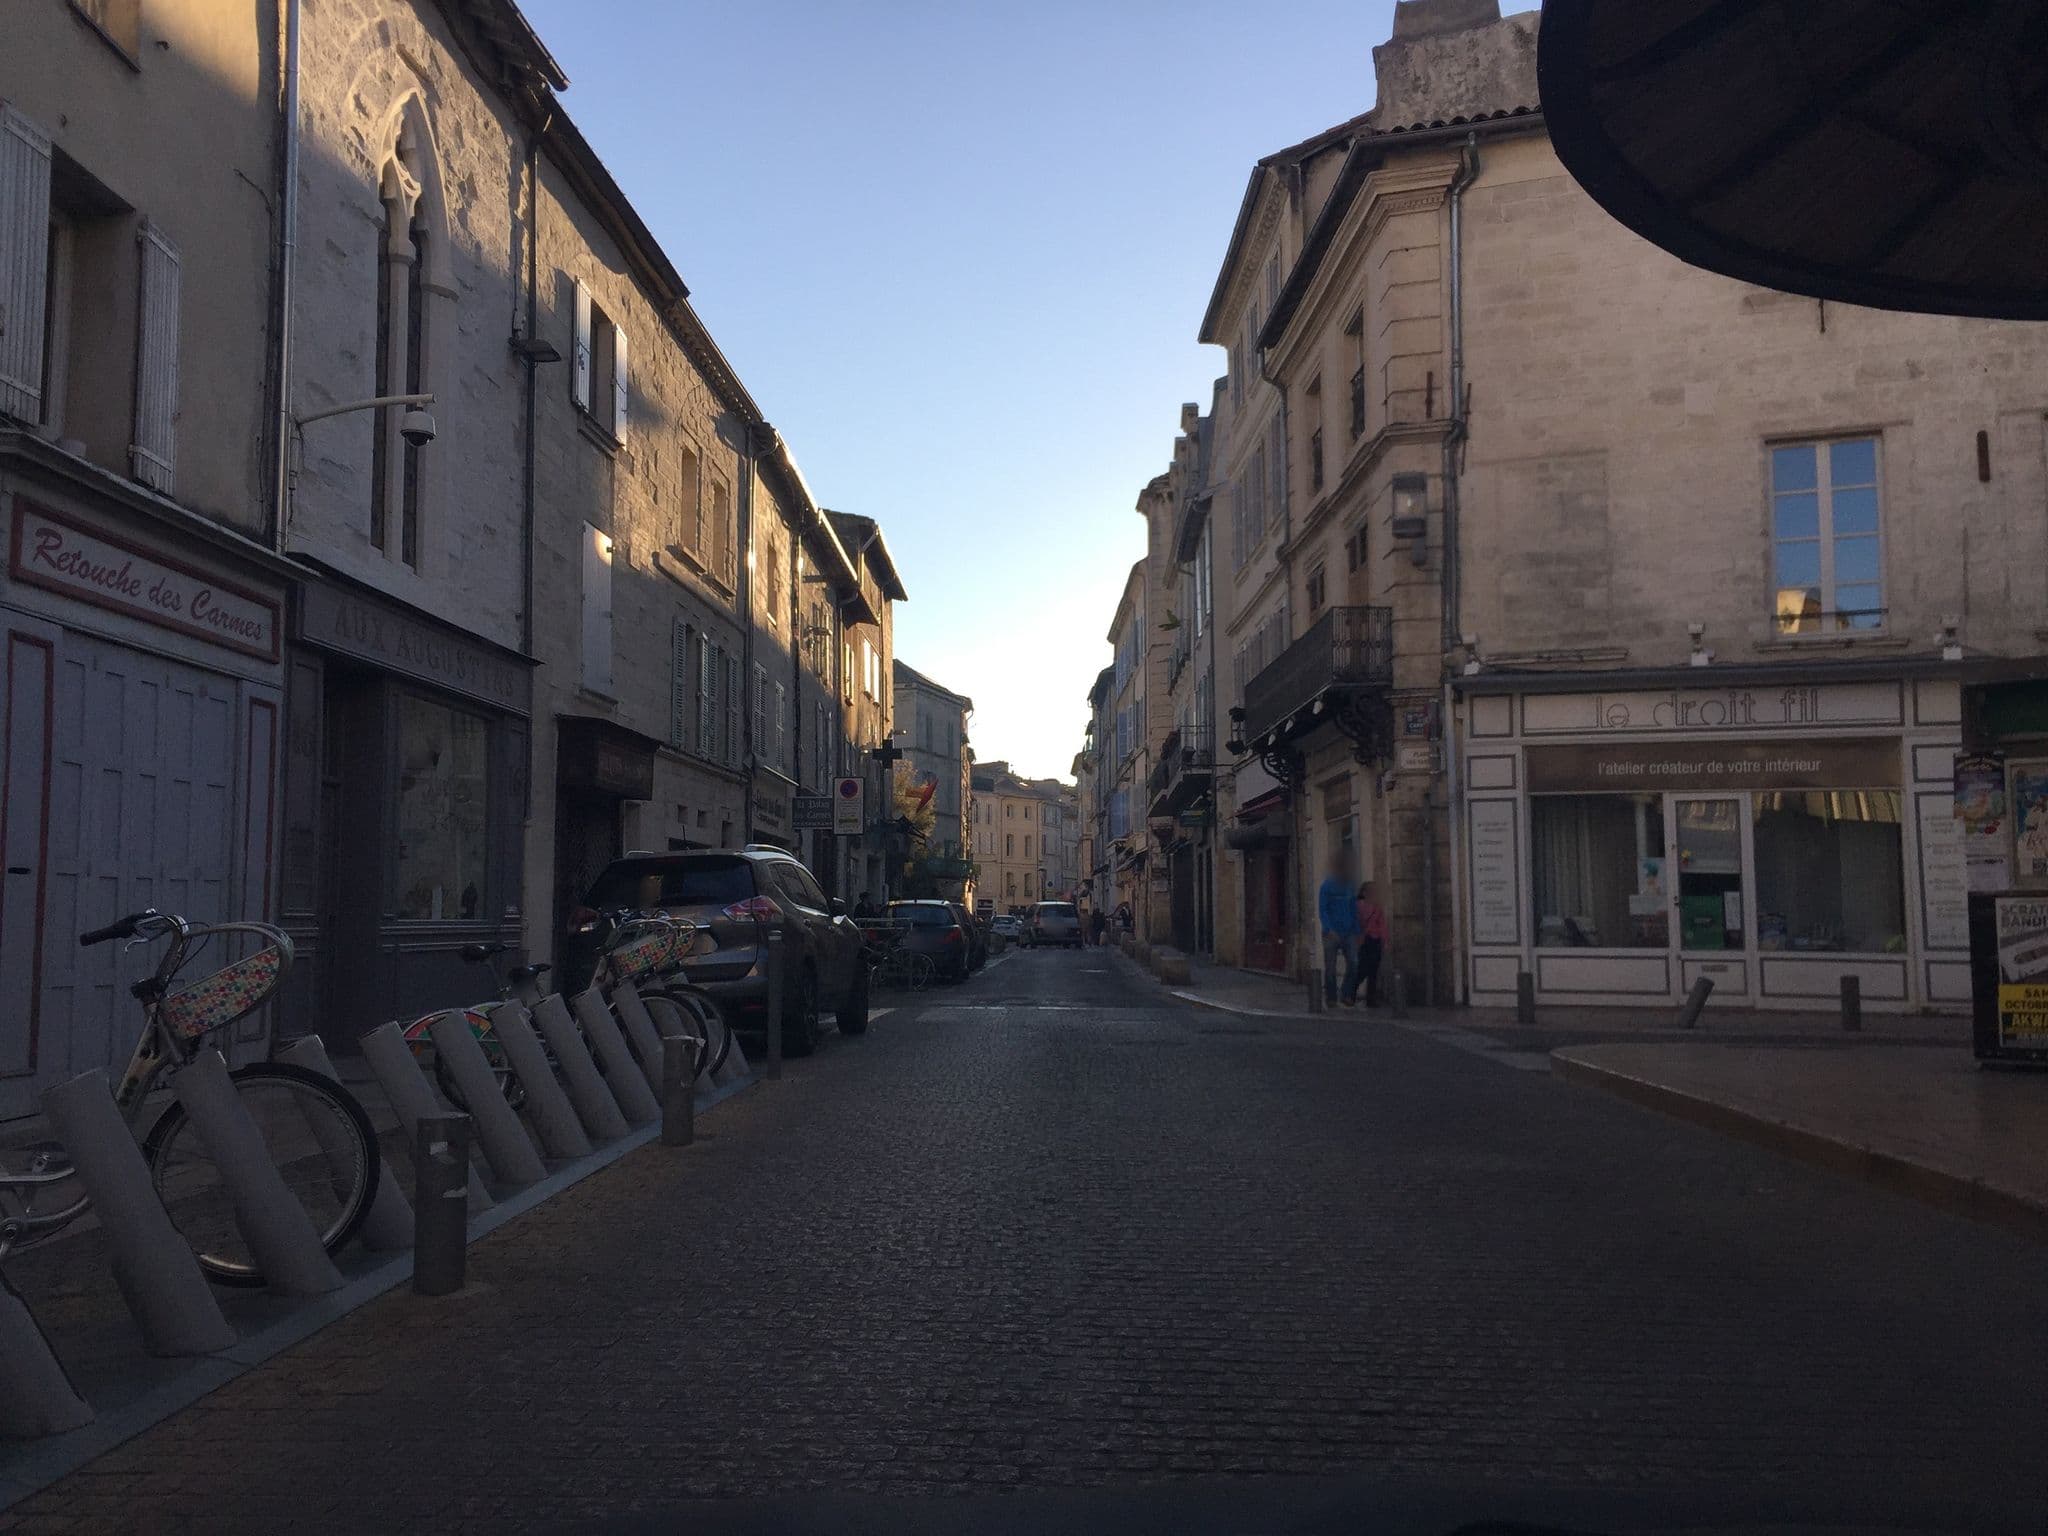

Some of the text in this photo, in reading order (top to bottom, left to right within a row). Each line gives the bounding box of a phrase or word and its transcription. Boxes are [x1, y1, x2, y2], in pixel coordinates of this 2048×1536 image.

[33, 527, 263, 642] Retouche des Carmes
[335, 598, 515, 698] AUX AUGUSTINS
[1596, 687, 1819, 729] le droit fil
[1598, 757, 1822, 776] l'atelier créateur de votre intérieur
[2001, 904, 2048, 915] SCRAT
